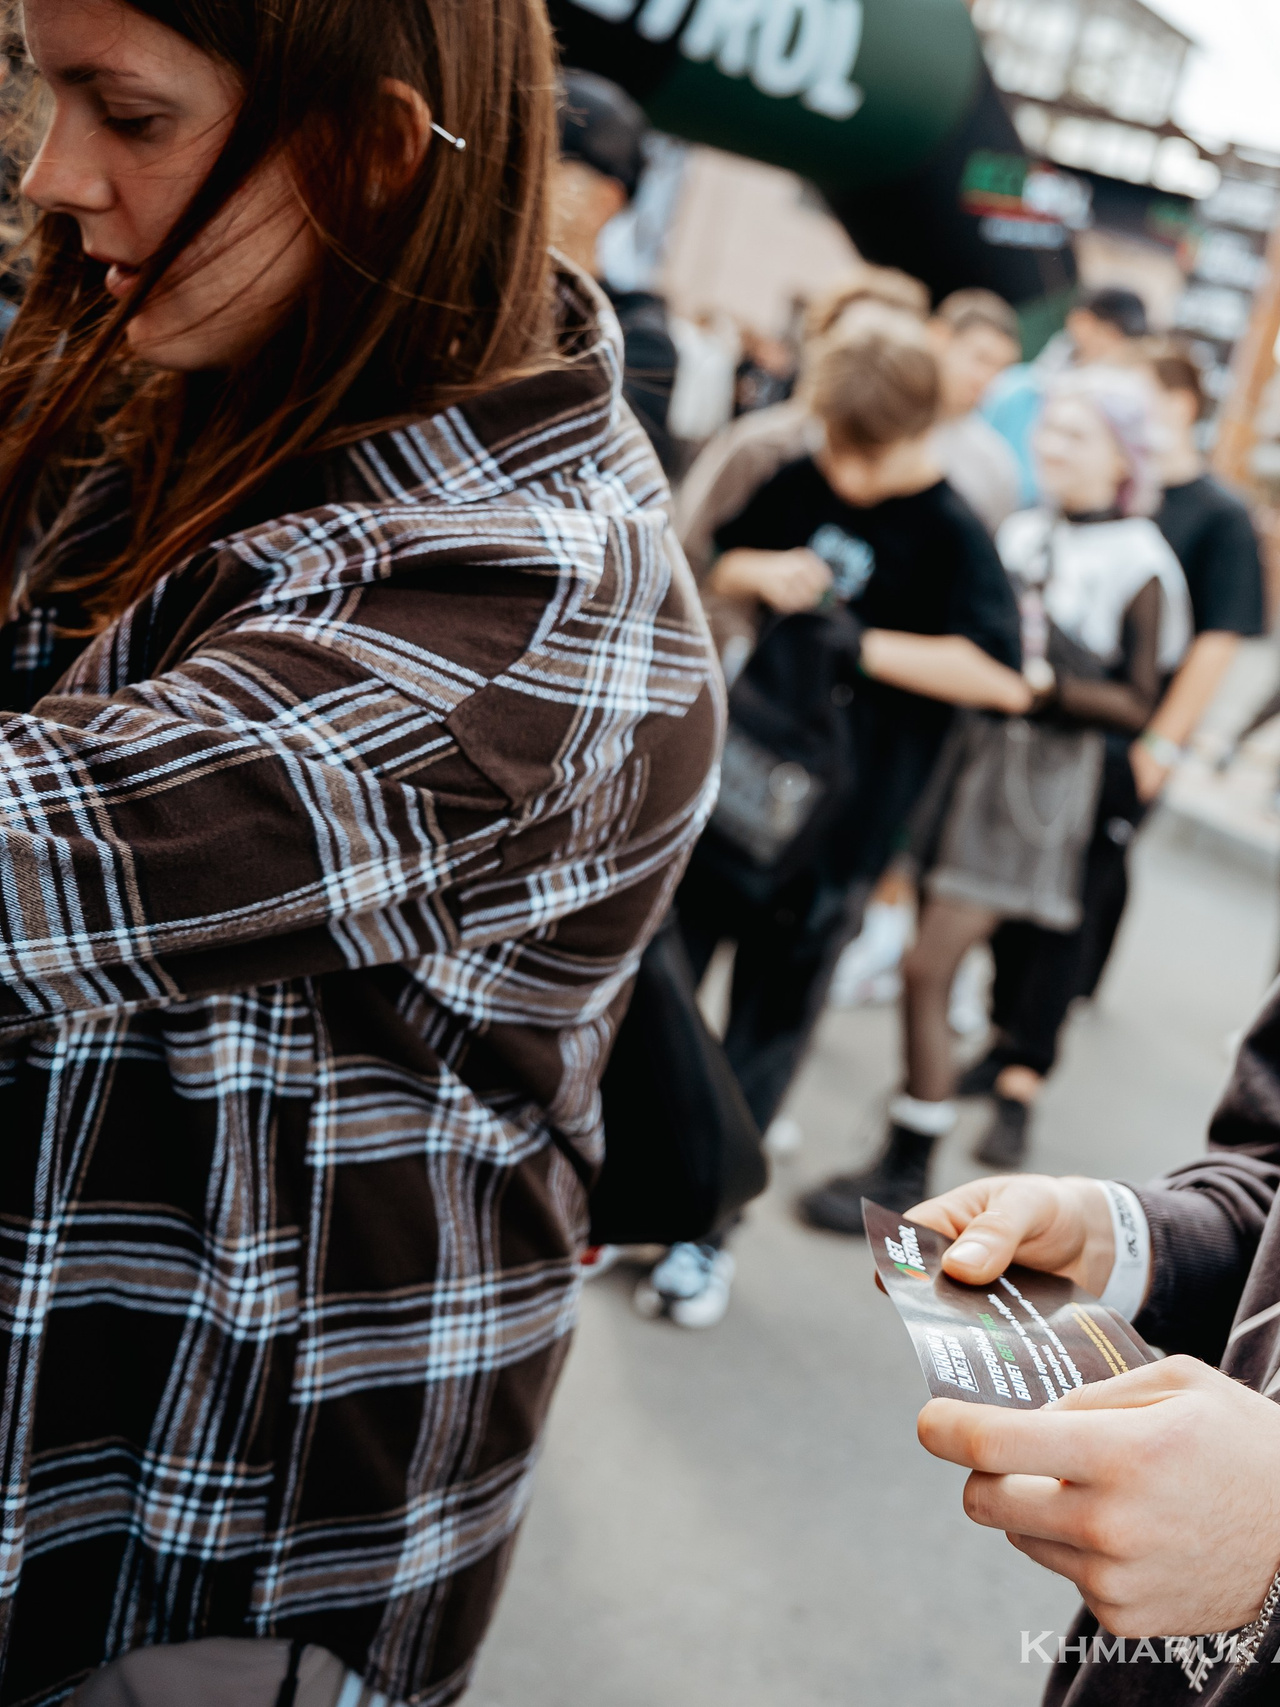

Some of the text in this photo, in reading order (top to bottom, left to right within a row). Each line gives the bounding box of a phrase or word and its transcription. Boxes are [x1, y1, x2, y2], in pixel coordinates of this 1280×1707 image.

[884, 1236, 907, 1264] GET
[898, 1225, 926, 1271] PETROL
[926, 1334, 959, 1384] PARKING
[967, 1326, 1012, 1399] ЛОТЕРЕЙНЫЙ
[1004, 1361, 1032, 1401] БИЛЕТ
